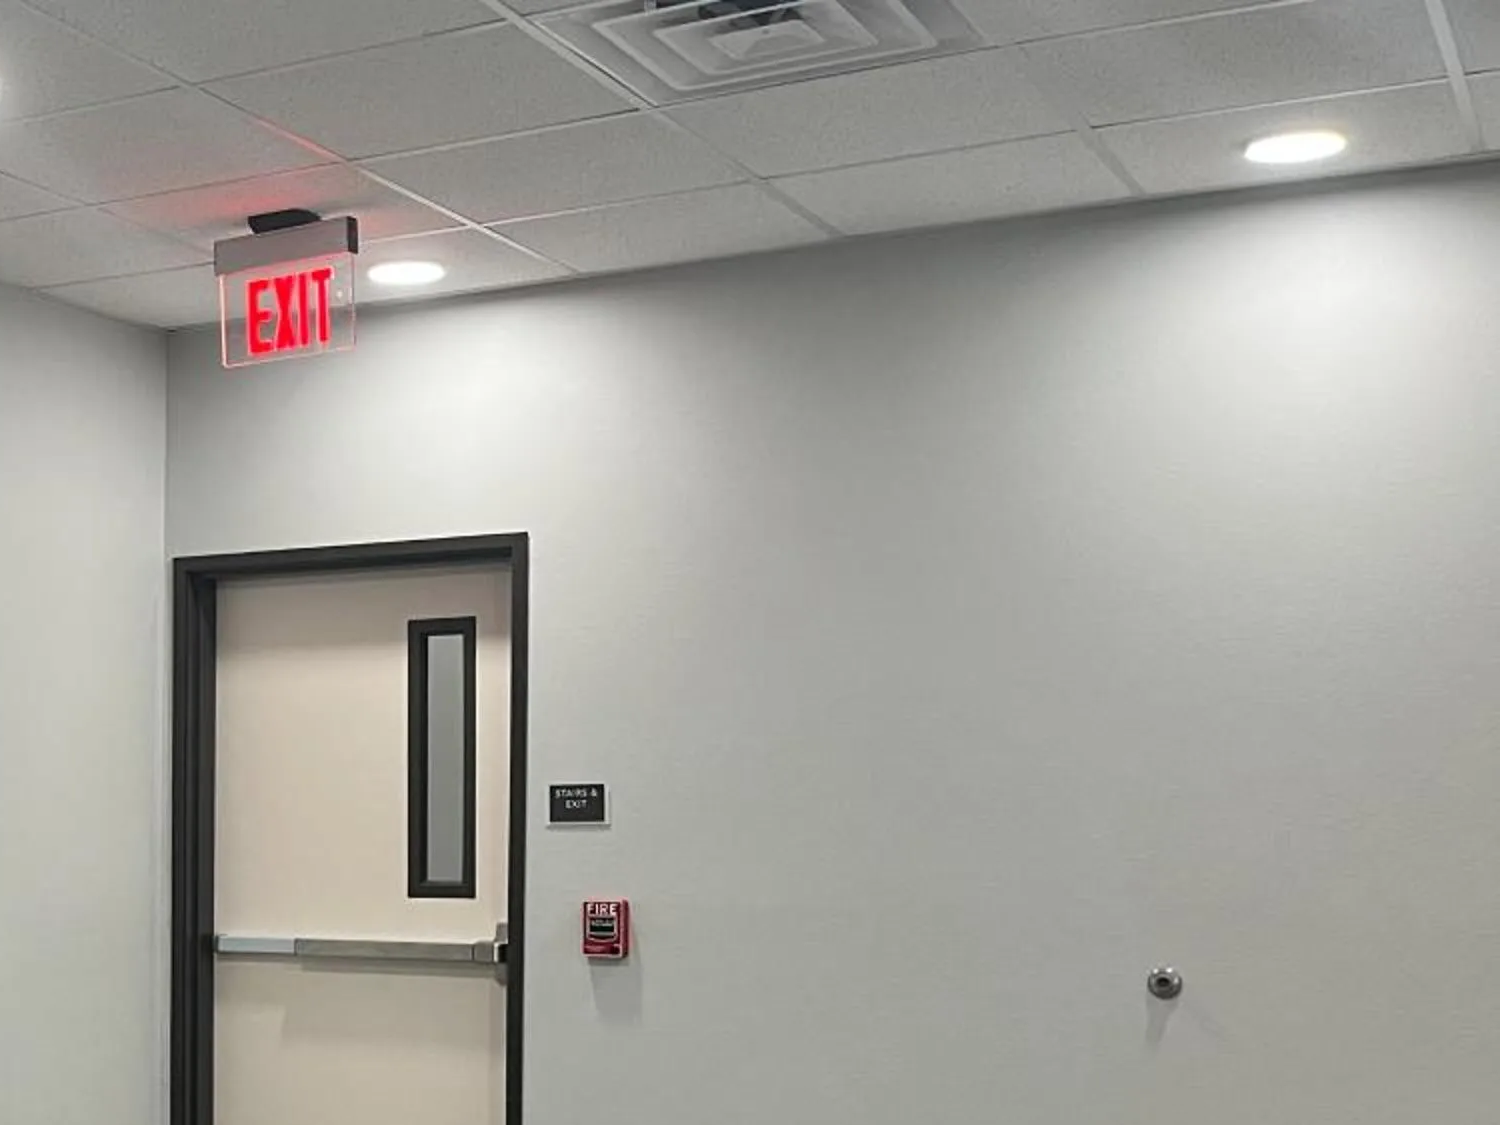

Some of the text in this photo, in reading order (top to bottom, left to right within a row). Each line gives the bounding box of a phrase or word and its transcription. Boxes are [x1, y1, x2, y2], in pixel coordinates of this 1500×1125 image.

[247, 267, 333, 355] EXIT
[555, 788, 587, 798] STAIRS
[565, 800, 587, 809] EXIT
[587, 903, 618, 915] FIRE
